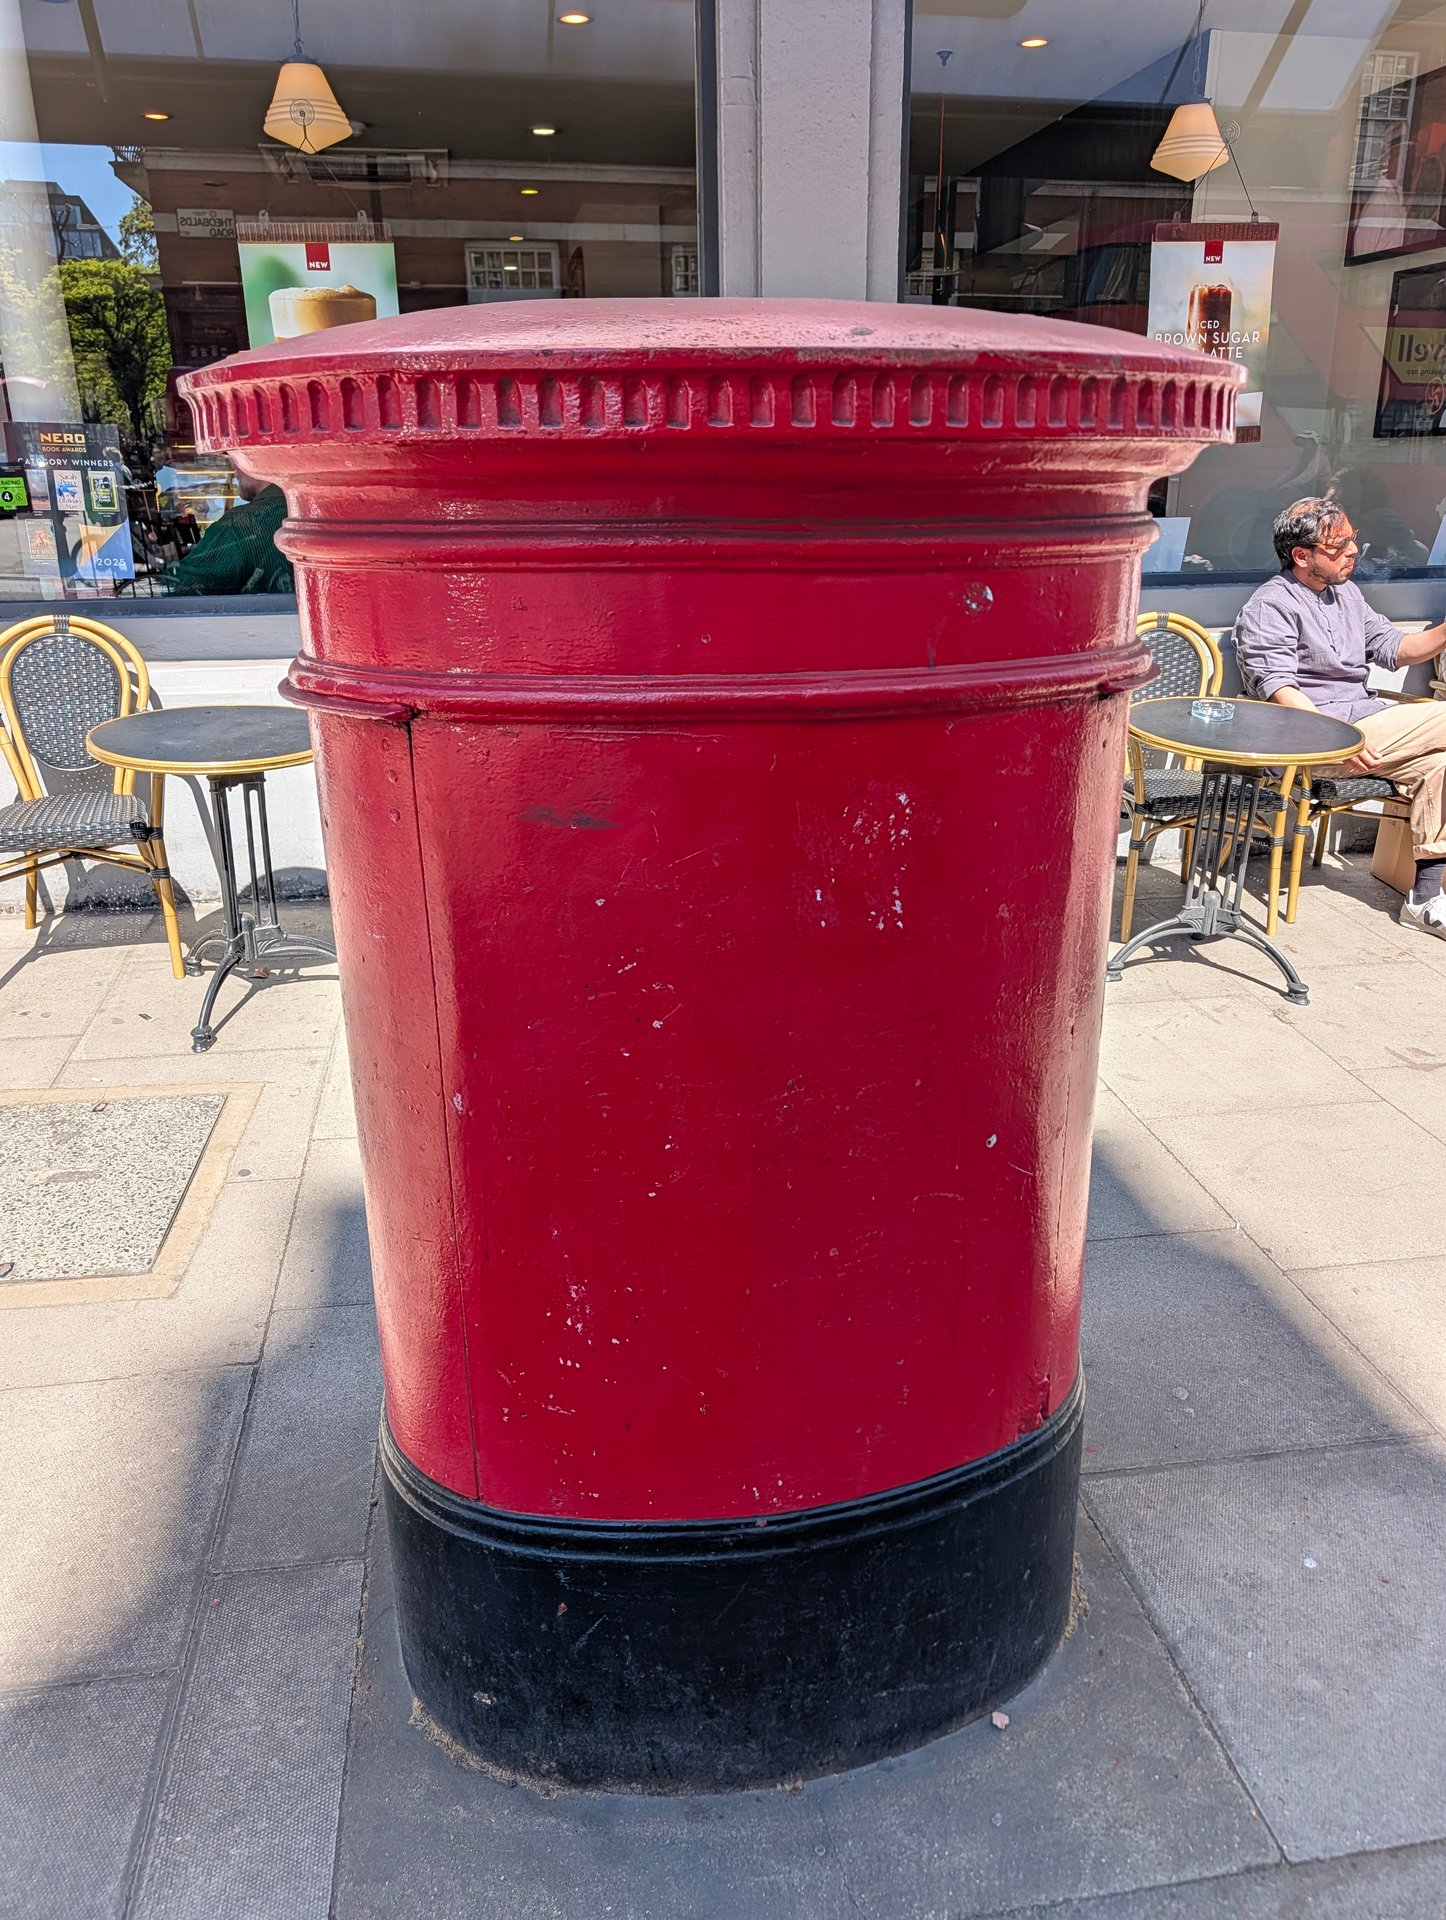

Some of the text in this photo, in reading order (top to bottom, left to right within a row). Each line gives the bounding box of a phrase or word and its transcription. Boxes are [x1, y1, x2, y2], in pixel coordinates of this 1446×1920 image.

[309, 261, 328, 269] NEW
[1197, 320, 1220, 329] ICED
[1155, 331, 1260, 345] BROWN SUGAR
[40, 433, 86, 443] NERO
[71, 459, 114, 467] WINNERS
[4, 492, 11, 501] 4
[97, 558, 126, 567] 2025
